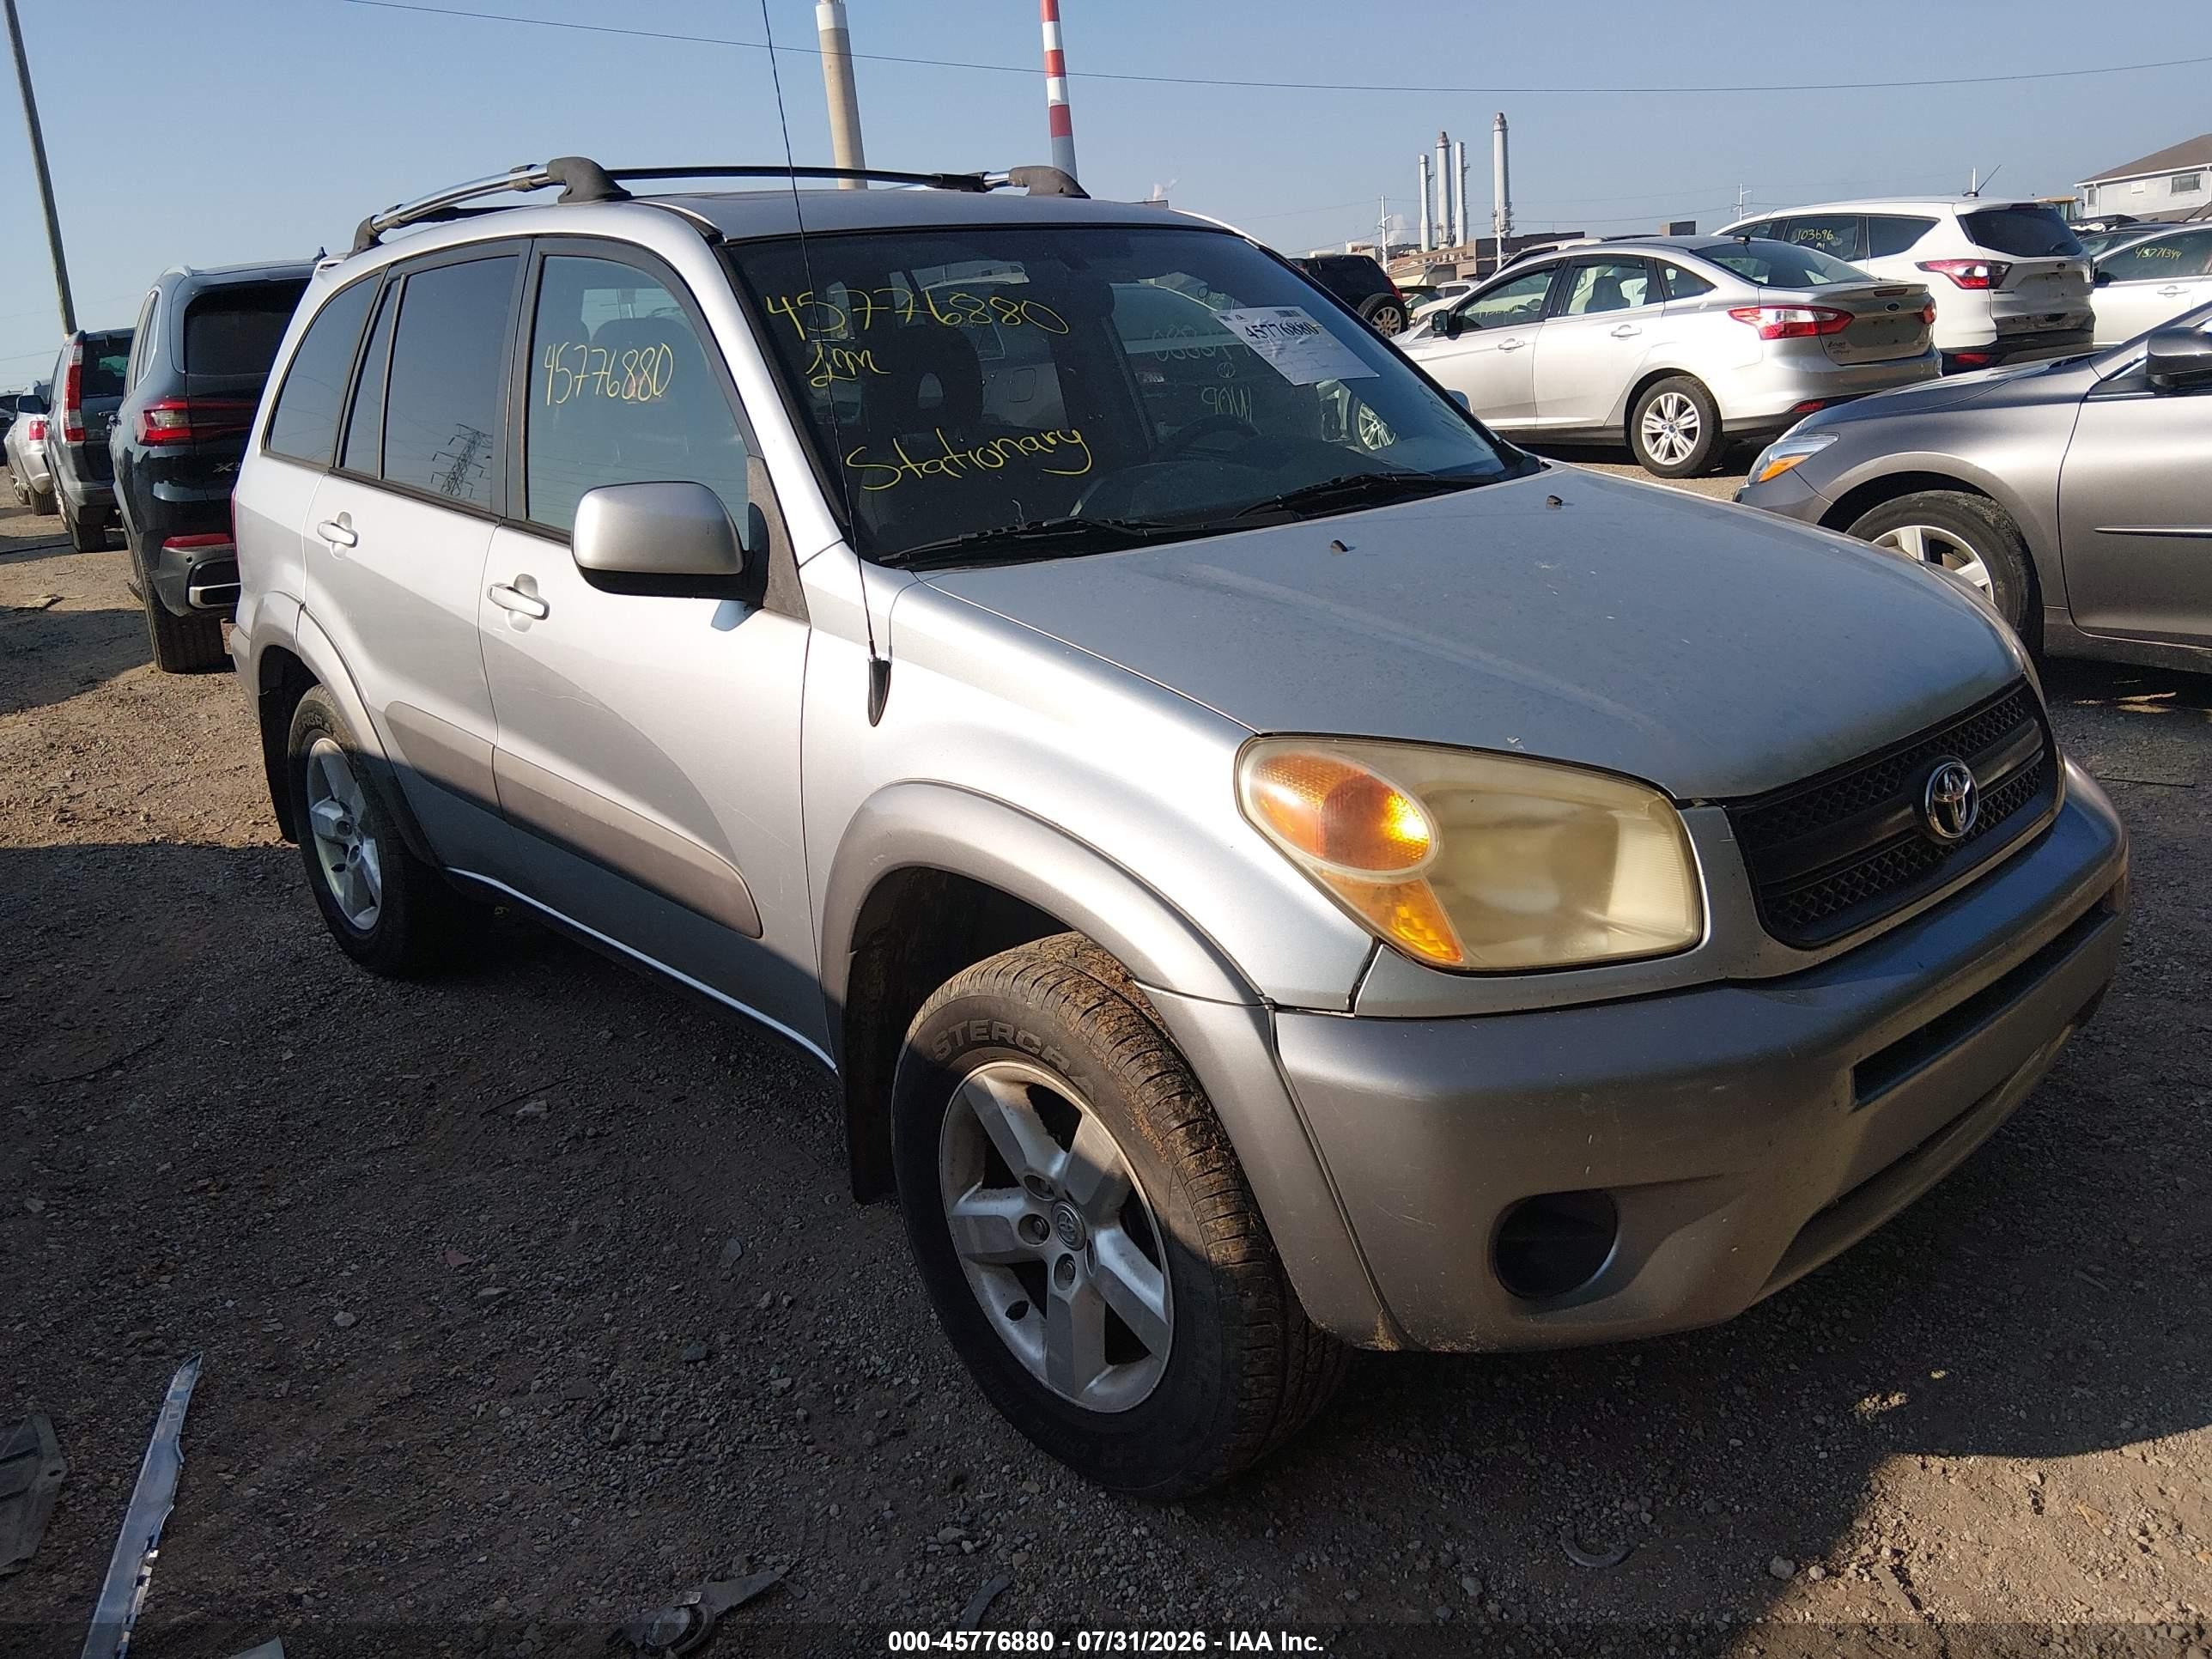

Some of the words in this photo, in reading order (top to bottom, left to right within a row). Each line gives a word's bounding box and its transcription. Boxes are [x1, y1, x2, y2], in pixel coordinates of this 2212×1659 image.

[764, 288, 1070, 342] 45776880
[1246, 320, 1320, 341] 45776880
[544, 342, 674, 406] 45776880
[846, 428, 1093, 490] Stationary
